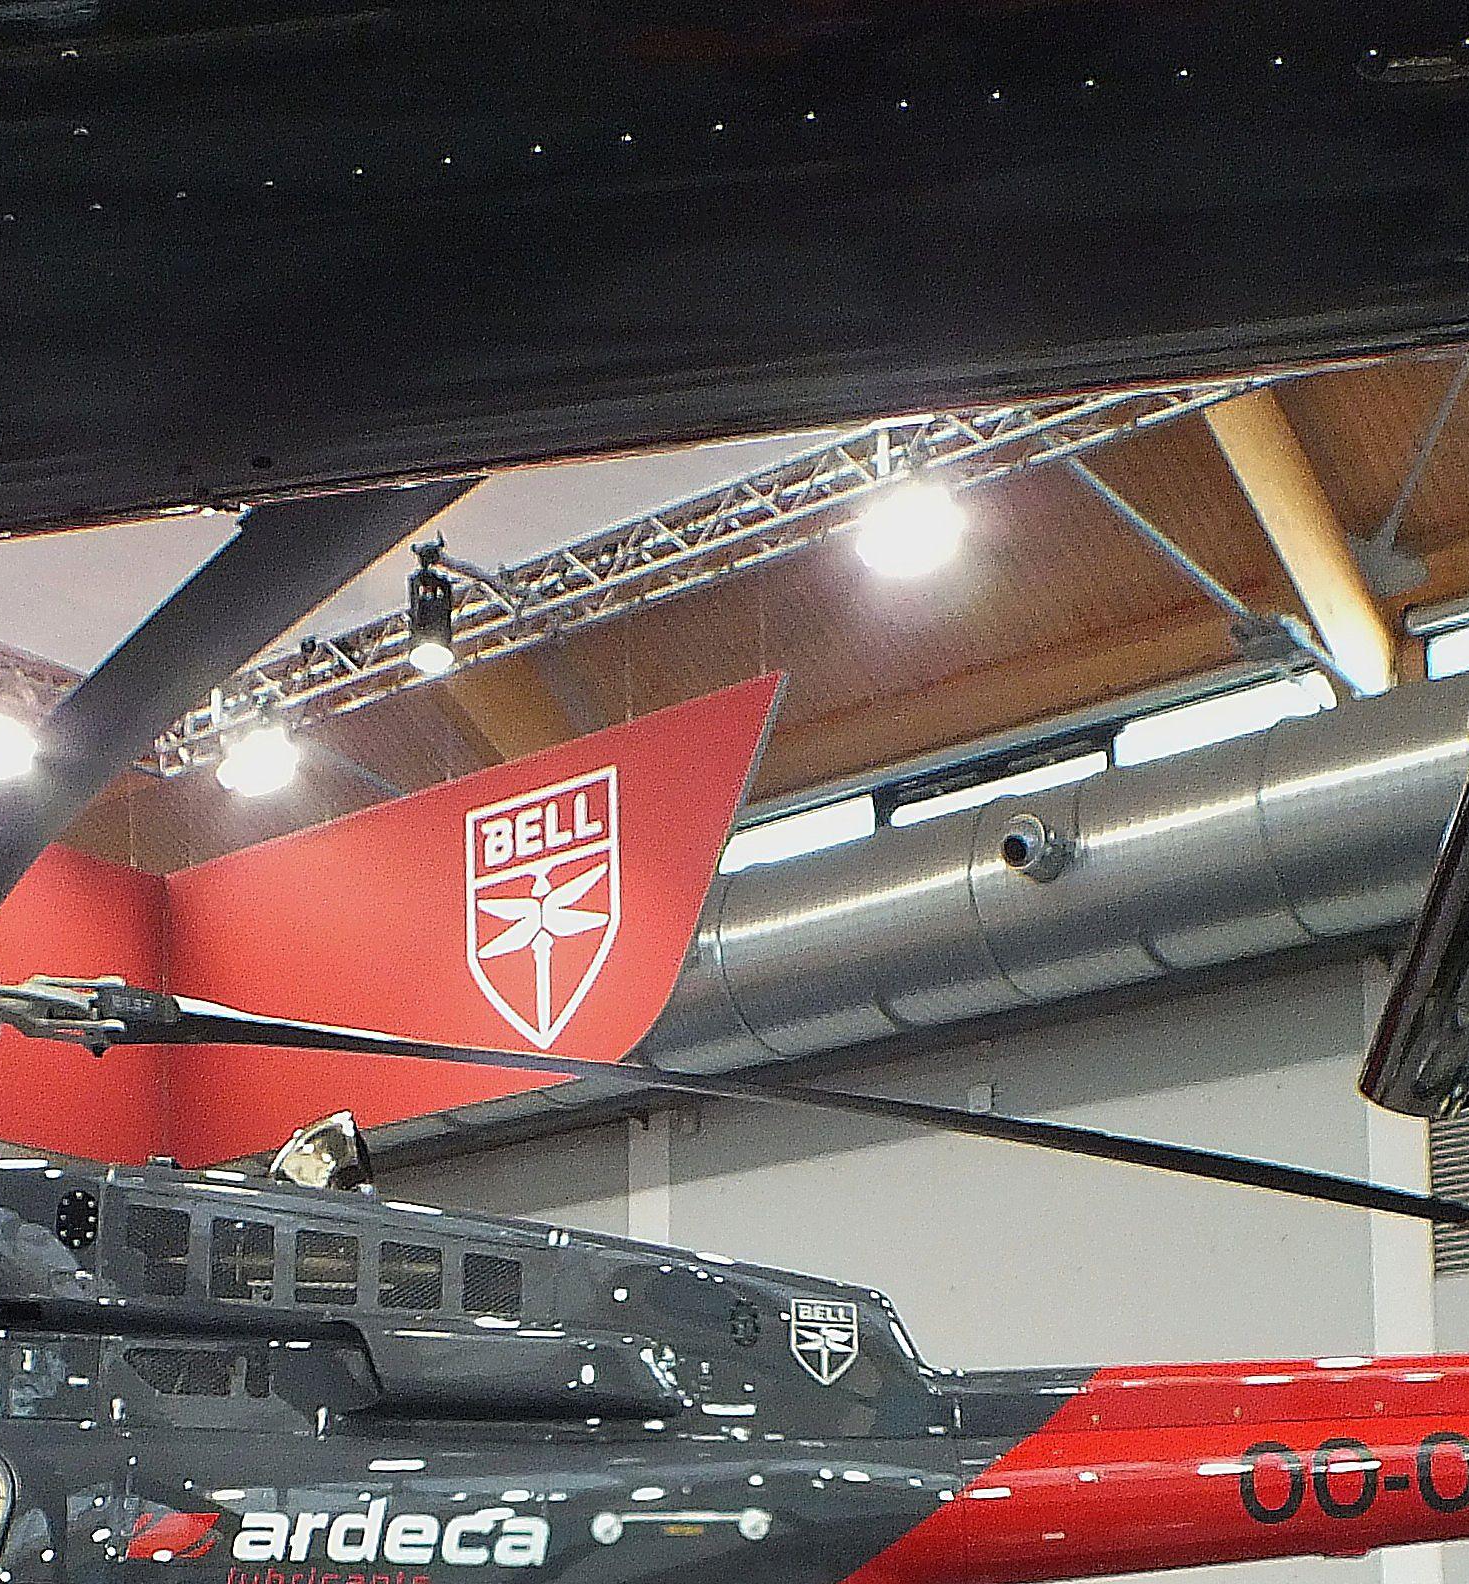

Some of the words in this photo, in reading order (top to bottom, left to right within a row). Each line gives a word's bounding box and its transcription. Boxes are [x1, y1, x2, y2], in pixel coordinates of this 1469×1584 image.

[481, 792, 603, 868] BELL
[799, 1304, 852, 1322] BELL
[232, 1498, 551, 1566] ardeca
